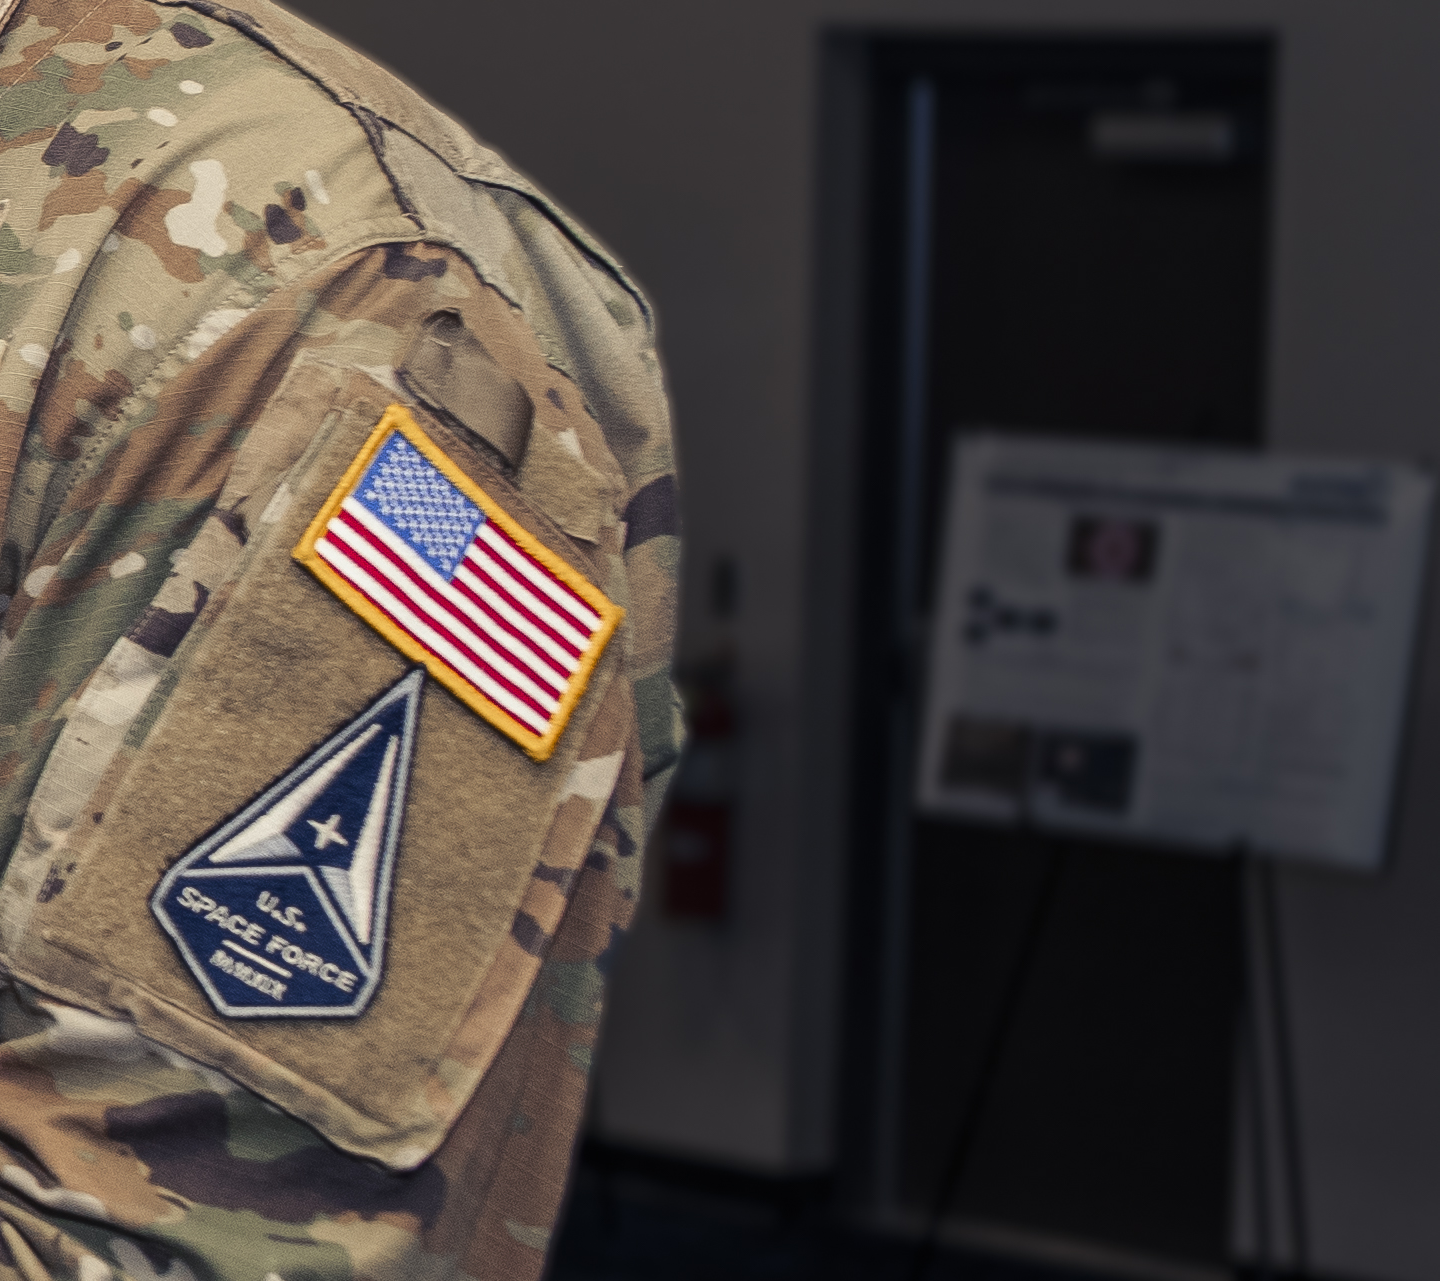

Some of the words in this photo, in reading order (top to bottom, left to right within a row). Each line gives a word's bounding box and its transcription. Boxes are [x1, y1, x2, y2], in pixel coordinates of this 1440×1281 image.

[176, 886, 267, 946] SPACE
[265, 934, 359, 993] FORCE
[255, 890, 308, 933] U.S.
